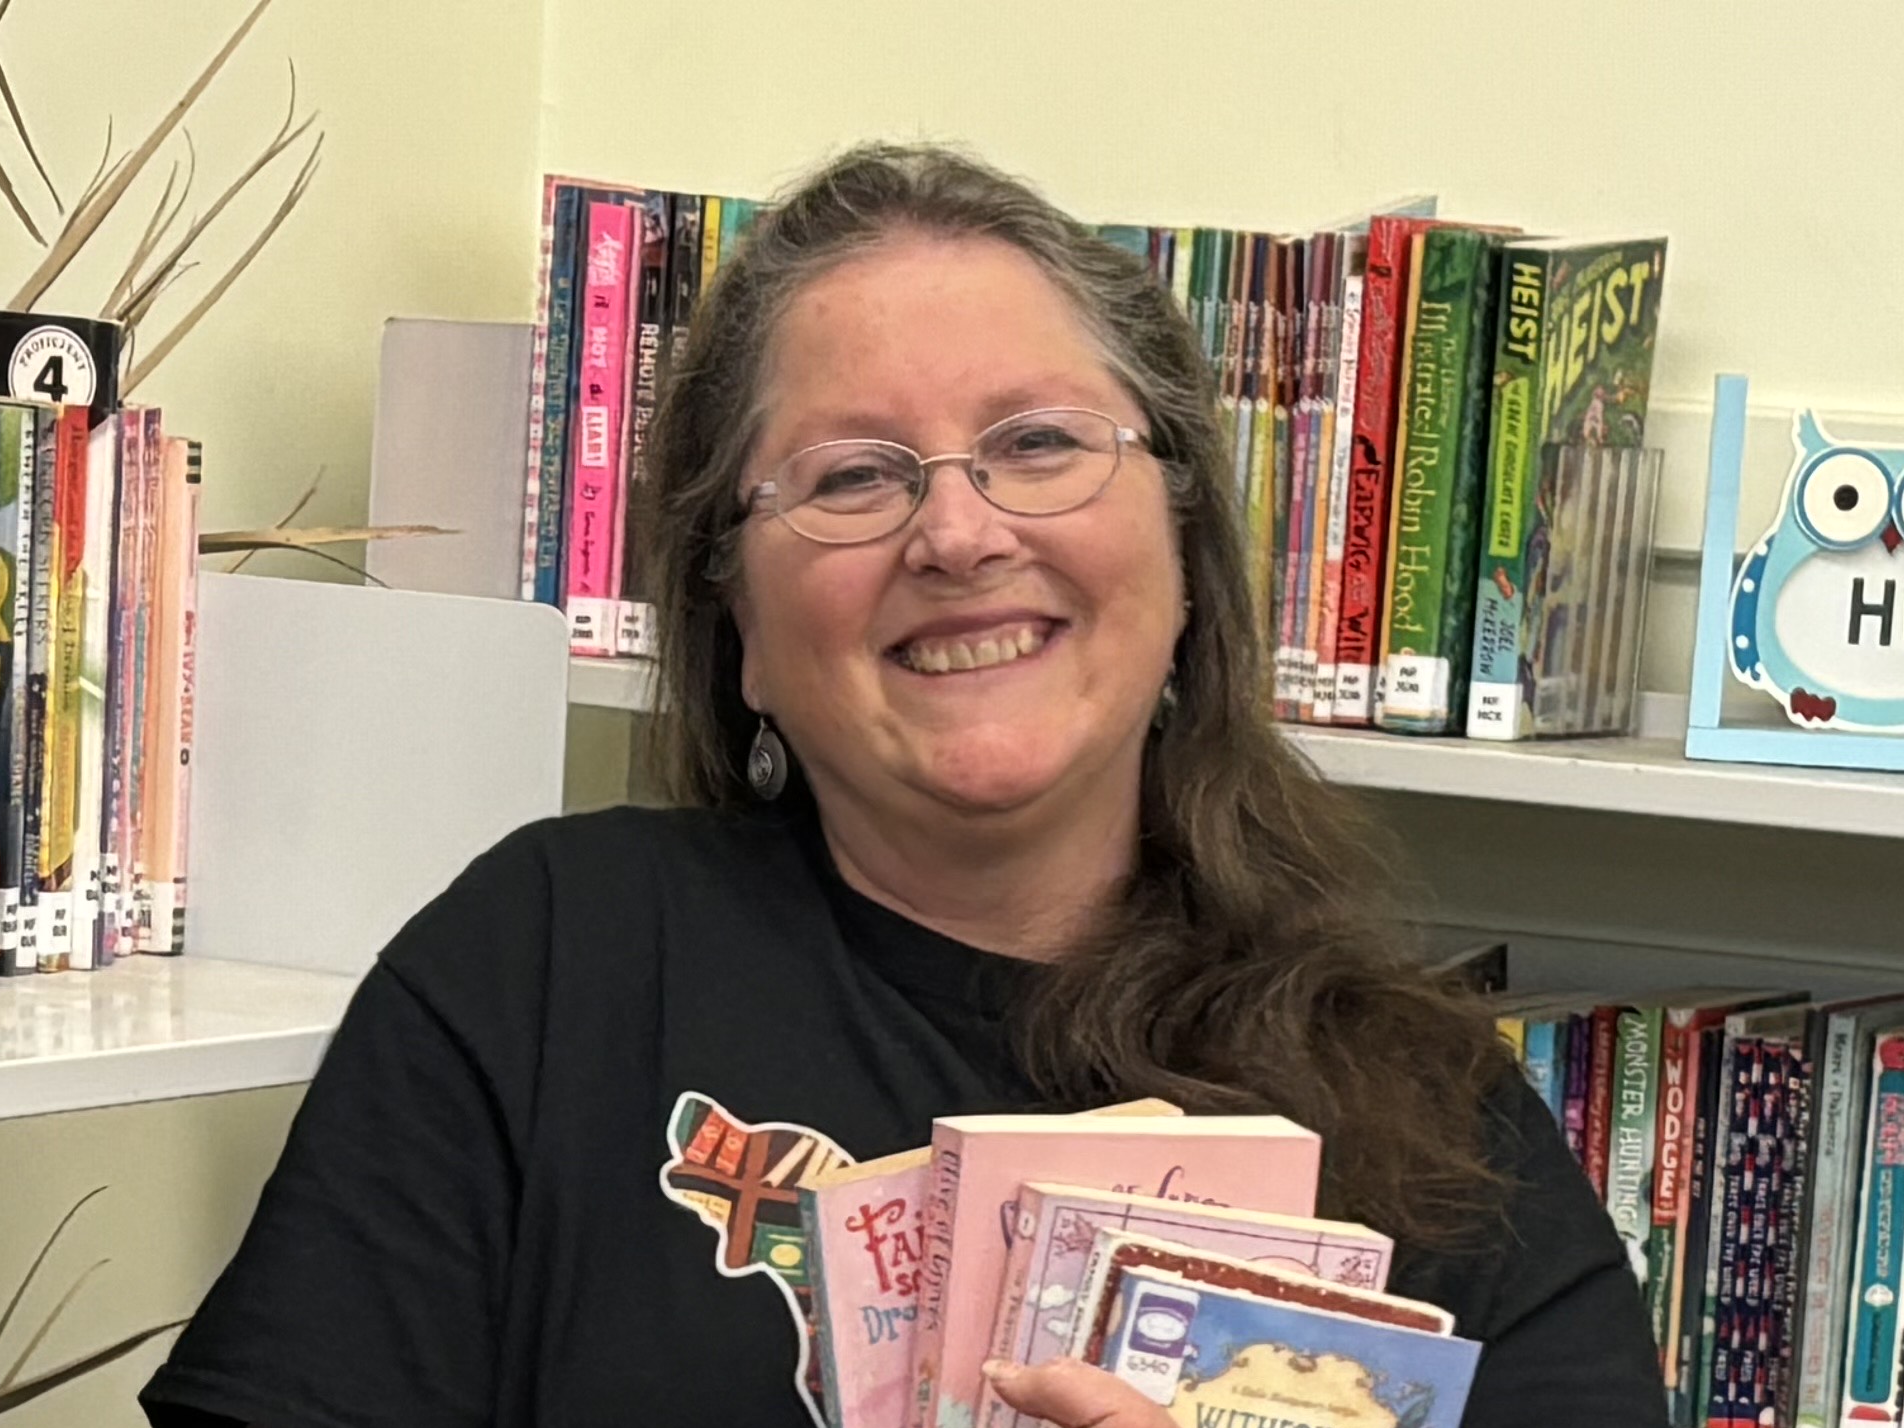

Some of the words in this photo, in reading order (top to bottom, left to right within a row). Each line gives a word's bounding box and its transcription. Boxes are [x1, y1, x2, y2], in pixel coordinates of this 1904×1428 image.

[1505, 261, 1542, 366] HEIST
[1541, 260, 1650, 438] HEIST
[32, 355, 69, 401] 4
[1404, 443, 1440, 534] Robin
[1393, 544, 1432, 634] Hood
[1621, 1016, 1650, 1121] MONSTER
[1615, 1126, 1644, 1230] HUNTING
